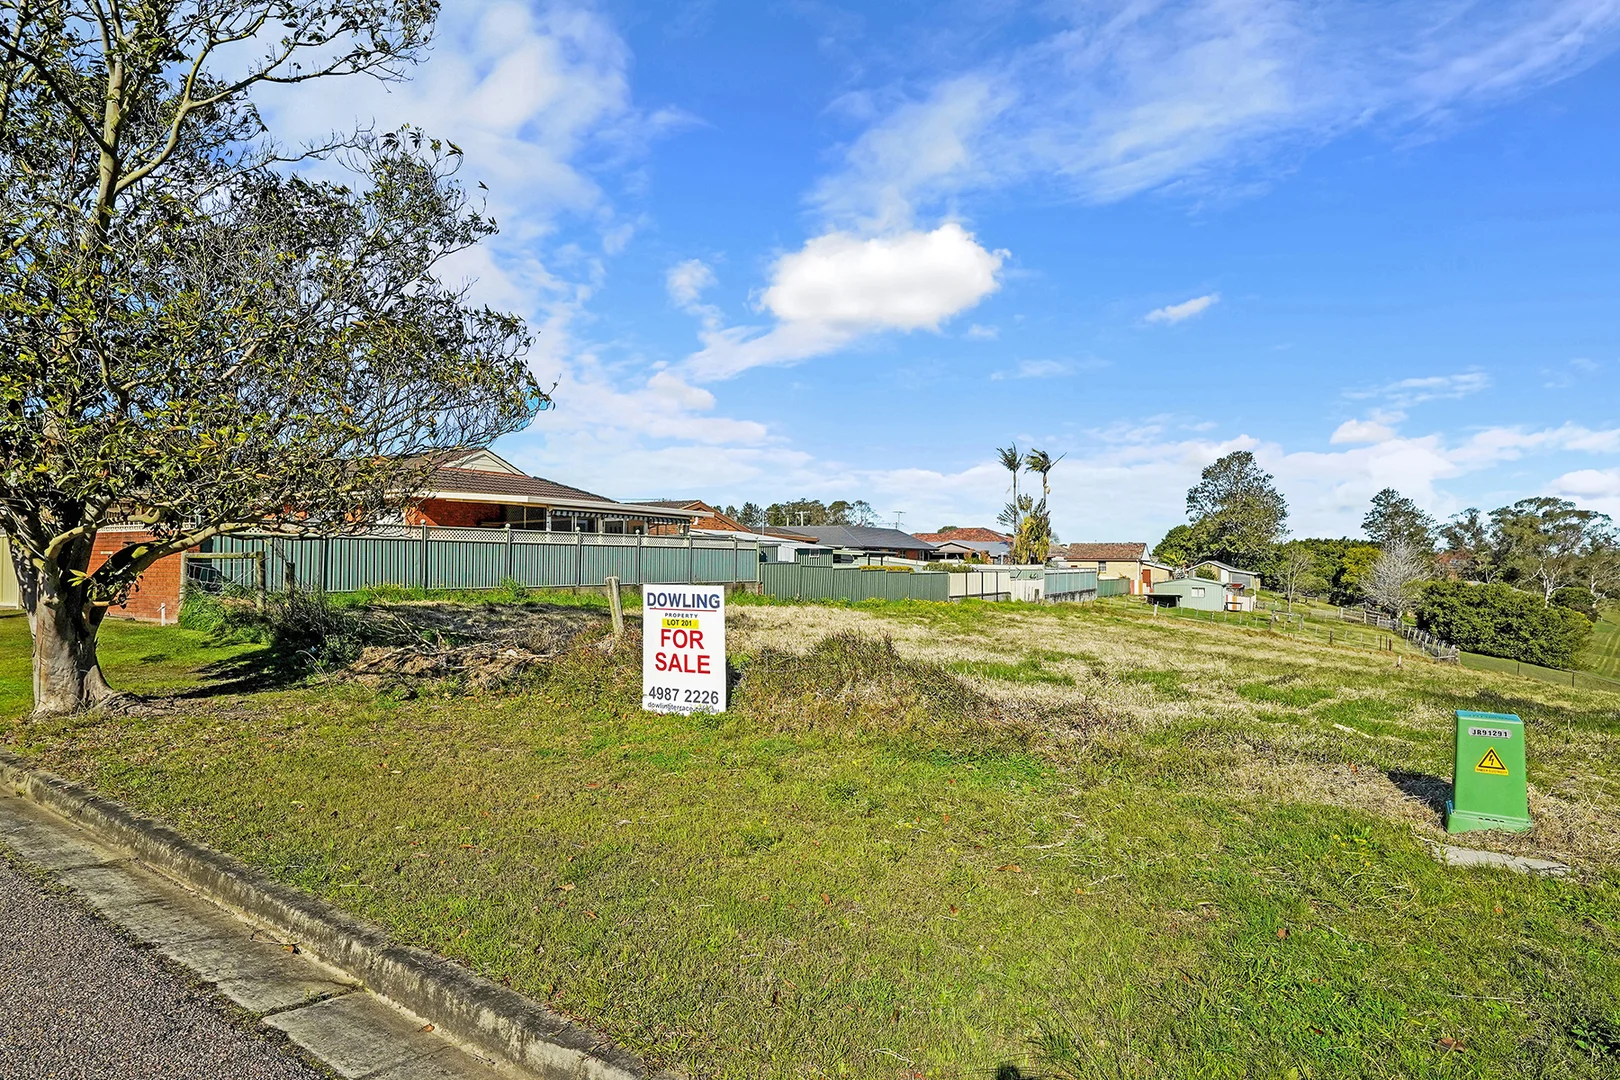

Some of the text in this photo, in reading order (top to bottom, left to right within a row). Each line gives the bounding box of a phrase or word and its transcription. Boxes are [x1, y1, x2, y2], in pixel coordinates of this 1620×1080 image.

[647, 592, 720, 608] DOWLING
[661, 628, 704, 649] FOR
[655, 652, 710, 674] SALE
[649, 686, 719, 705] 4987 2226
